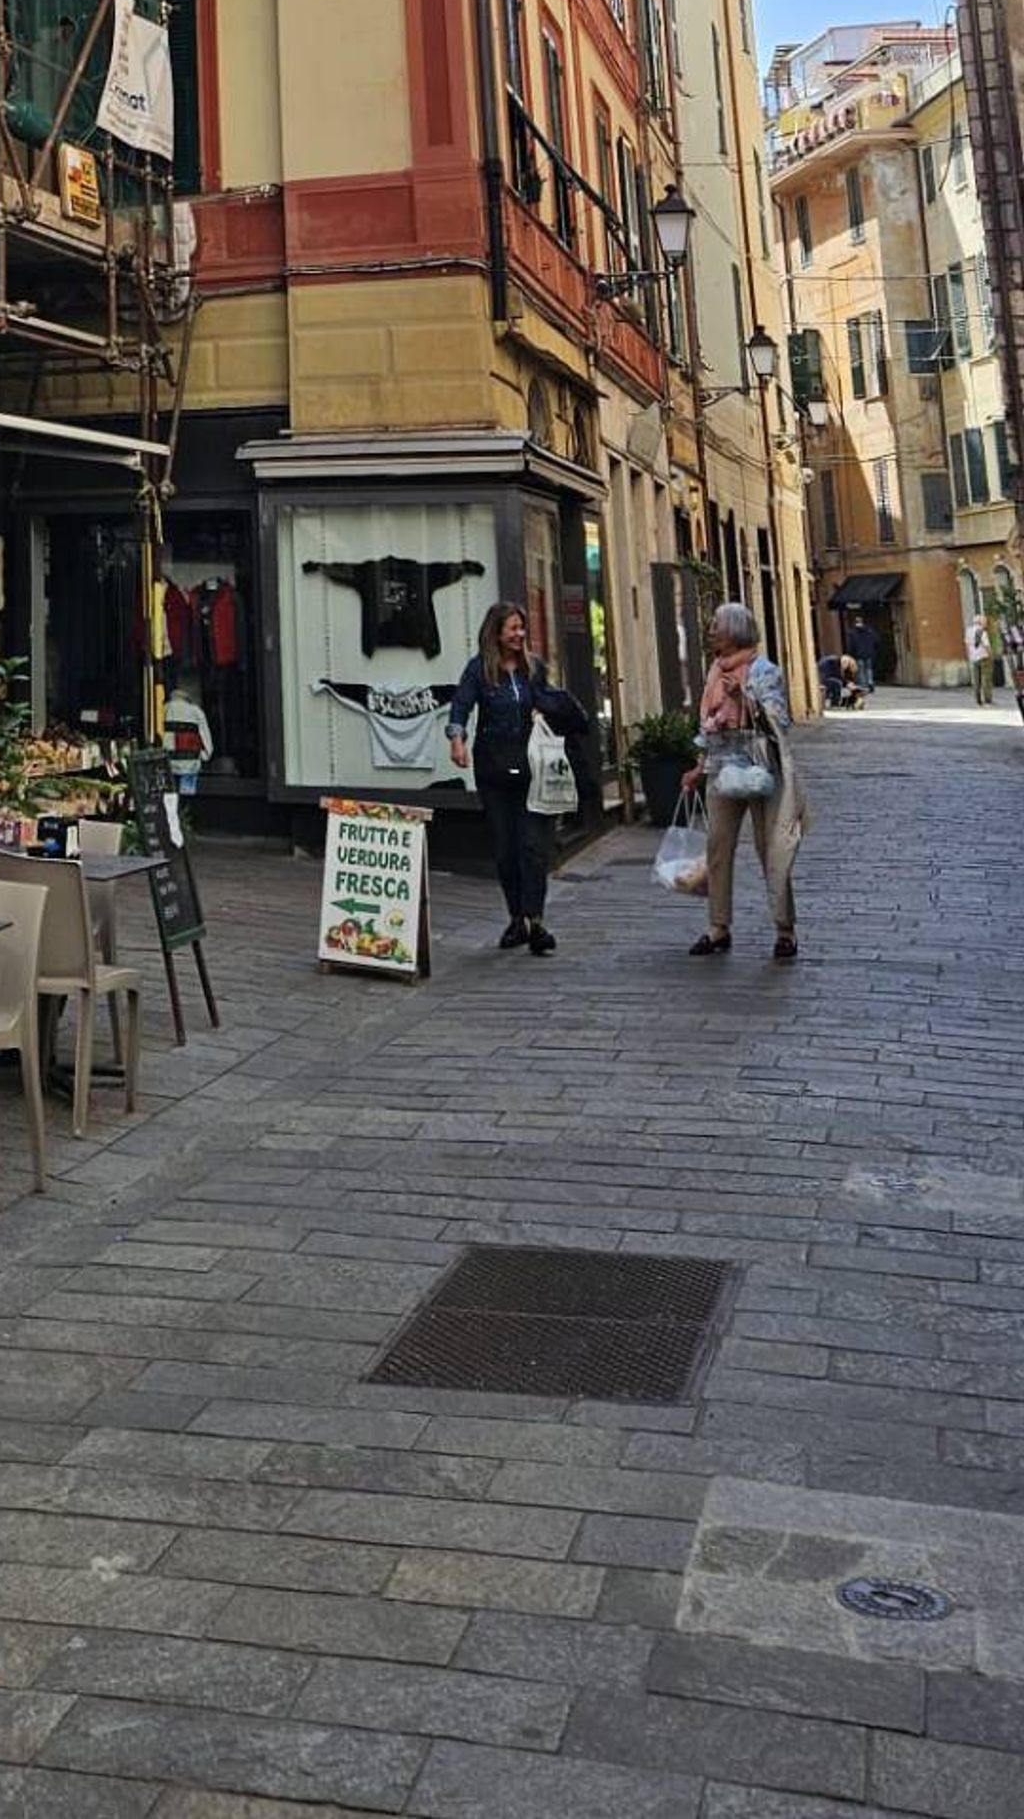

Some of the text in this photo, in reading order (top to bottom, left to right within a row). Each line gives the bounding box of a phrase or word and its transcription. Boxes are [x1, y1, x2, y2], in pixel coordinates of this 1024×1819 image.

[339, 822, 412, 849] FRUTTA E
[337, 846, 411, 872] VERDURA
[336, 872, 410, 901] FRESCA
